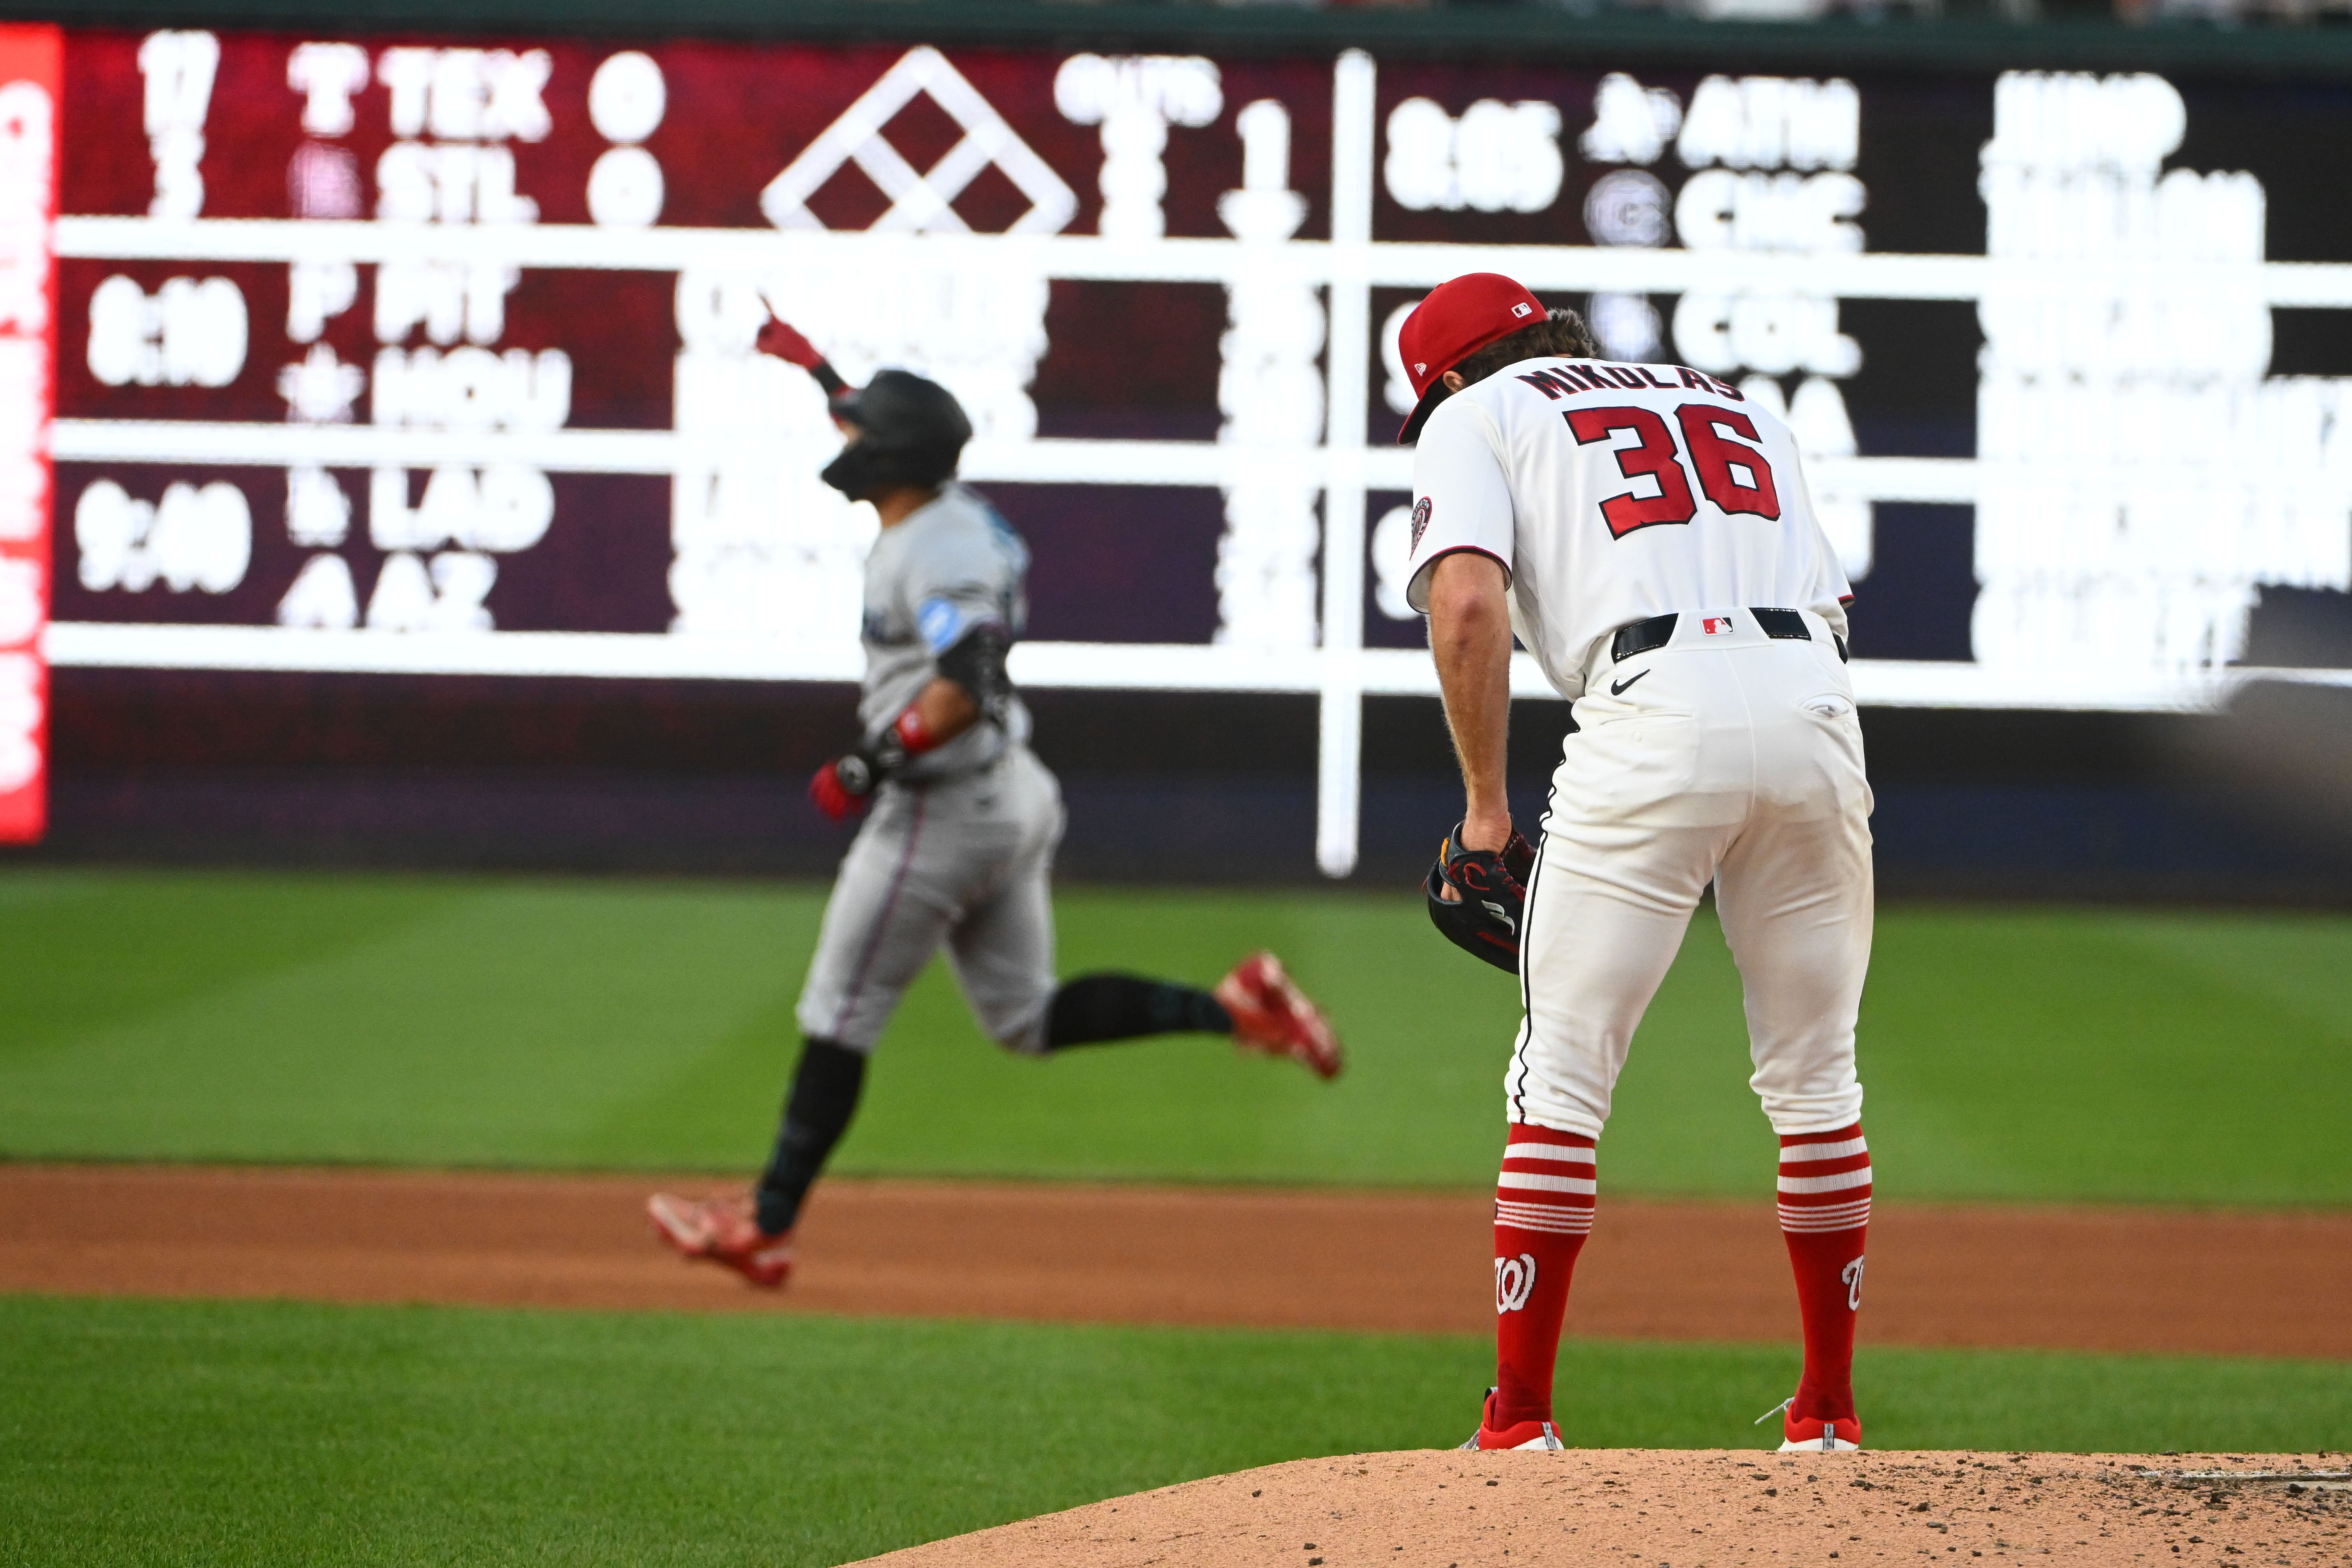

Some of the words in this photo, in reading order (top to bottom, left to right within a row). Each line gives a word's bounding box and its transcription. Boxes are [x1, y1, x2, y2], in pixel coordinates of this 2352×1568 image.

[376, 46, 553, 143] TEX
[376, 143, 541, 225] STL
[1513, 365, 1745, 401] MIKOLAS
[1562, 403, 1781, 541] 36
